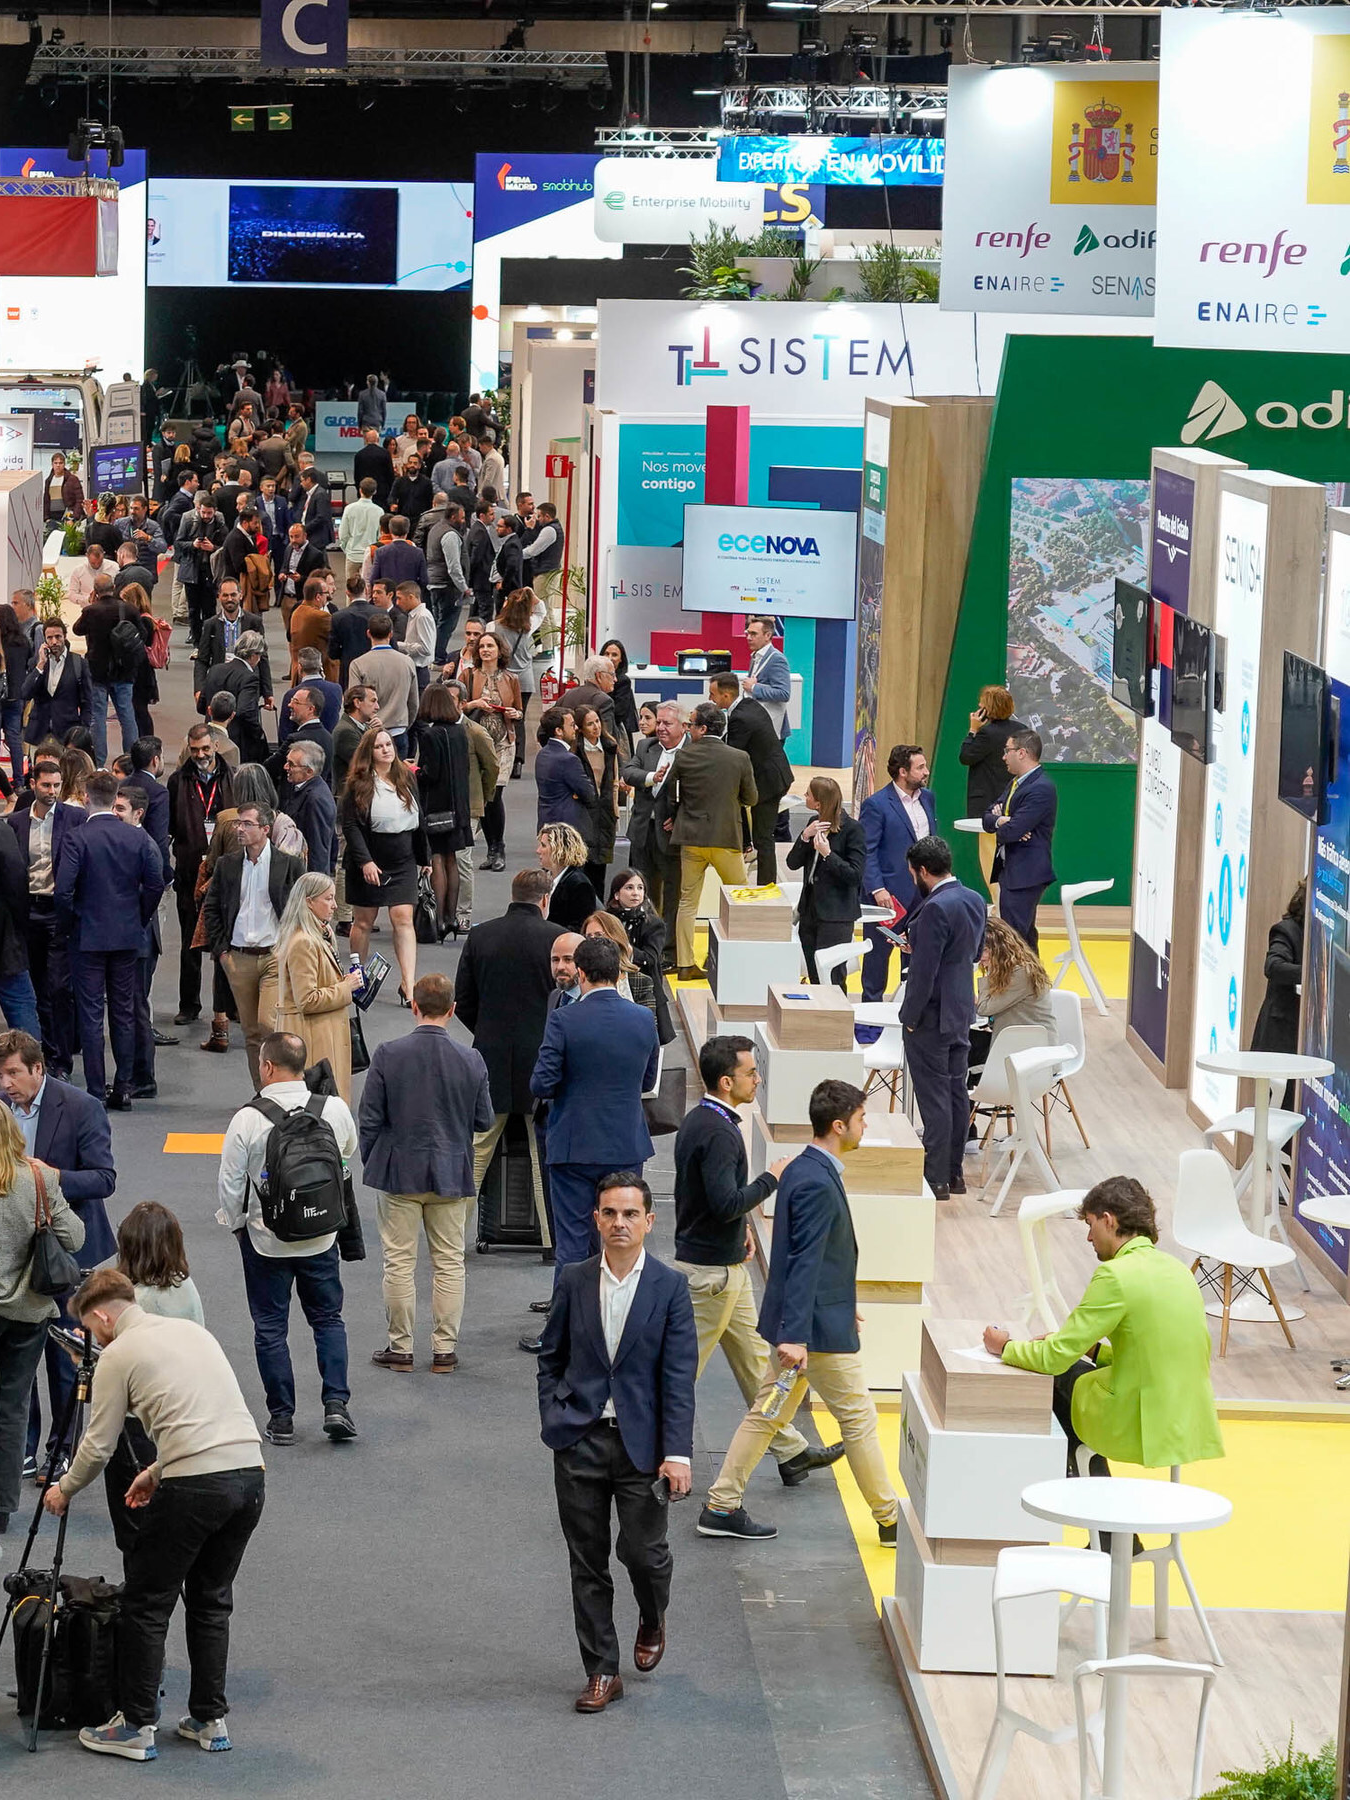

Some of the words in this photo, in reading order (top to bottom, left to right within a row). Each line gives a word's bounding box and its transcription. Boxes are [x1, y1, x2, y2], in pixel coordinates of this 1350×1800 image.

[282, 0, 328, 55] C
[827, 153, 856, 172] EN
[506, 176, 531, 184] IFEMA
[506, 183, 538, 191] MADRID
[633, 195, 696, 208] Enterprise
[700, 197, 751, 210] Mobility
[975, 222, 1051, 259] renfe
[1199, 230, 1307, 278] renfe
[738, 334, 915, 380] SISTEM
[3, 455, 24, 464] vida
[642, 461, 670, 473] Nos
[641, 478, 697, 492] contigo
[718, 533, 821, 556] eceNOVA
[755, 577, 781, 585] SISTEM
